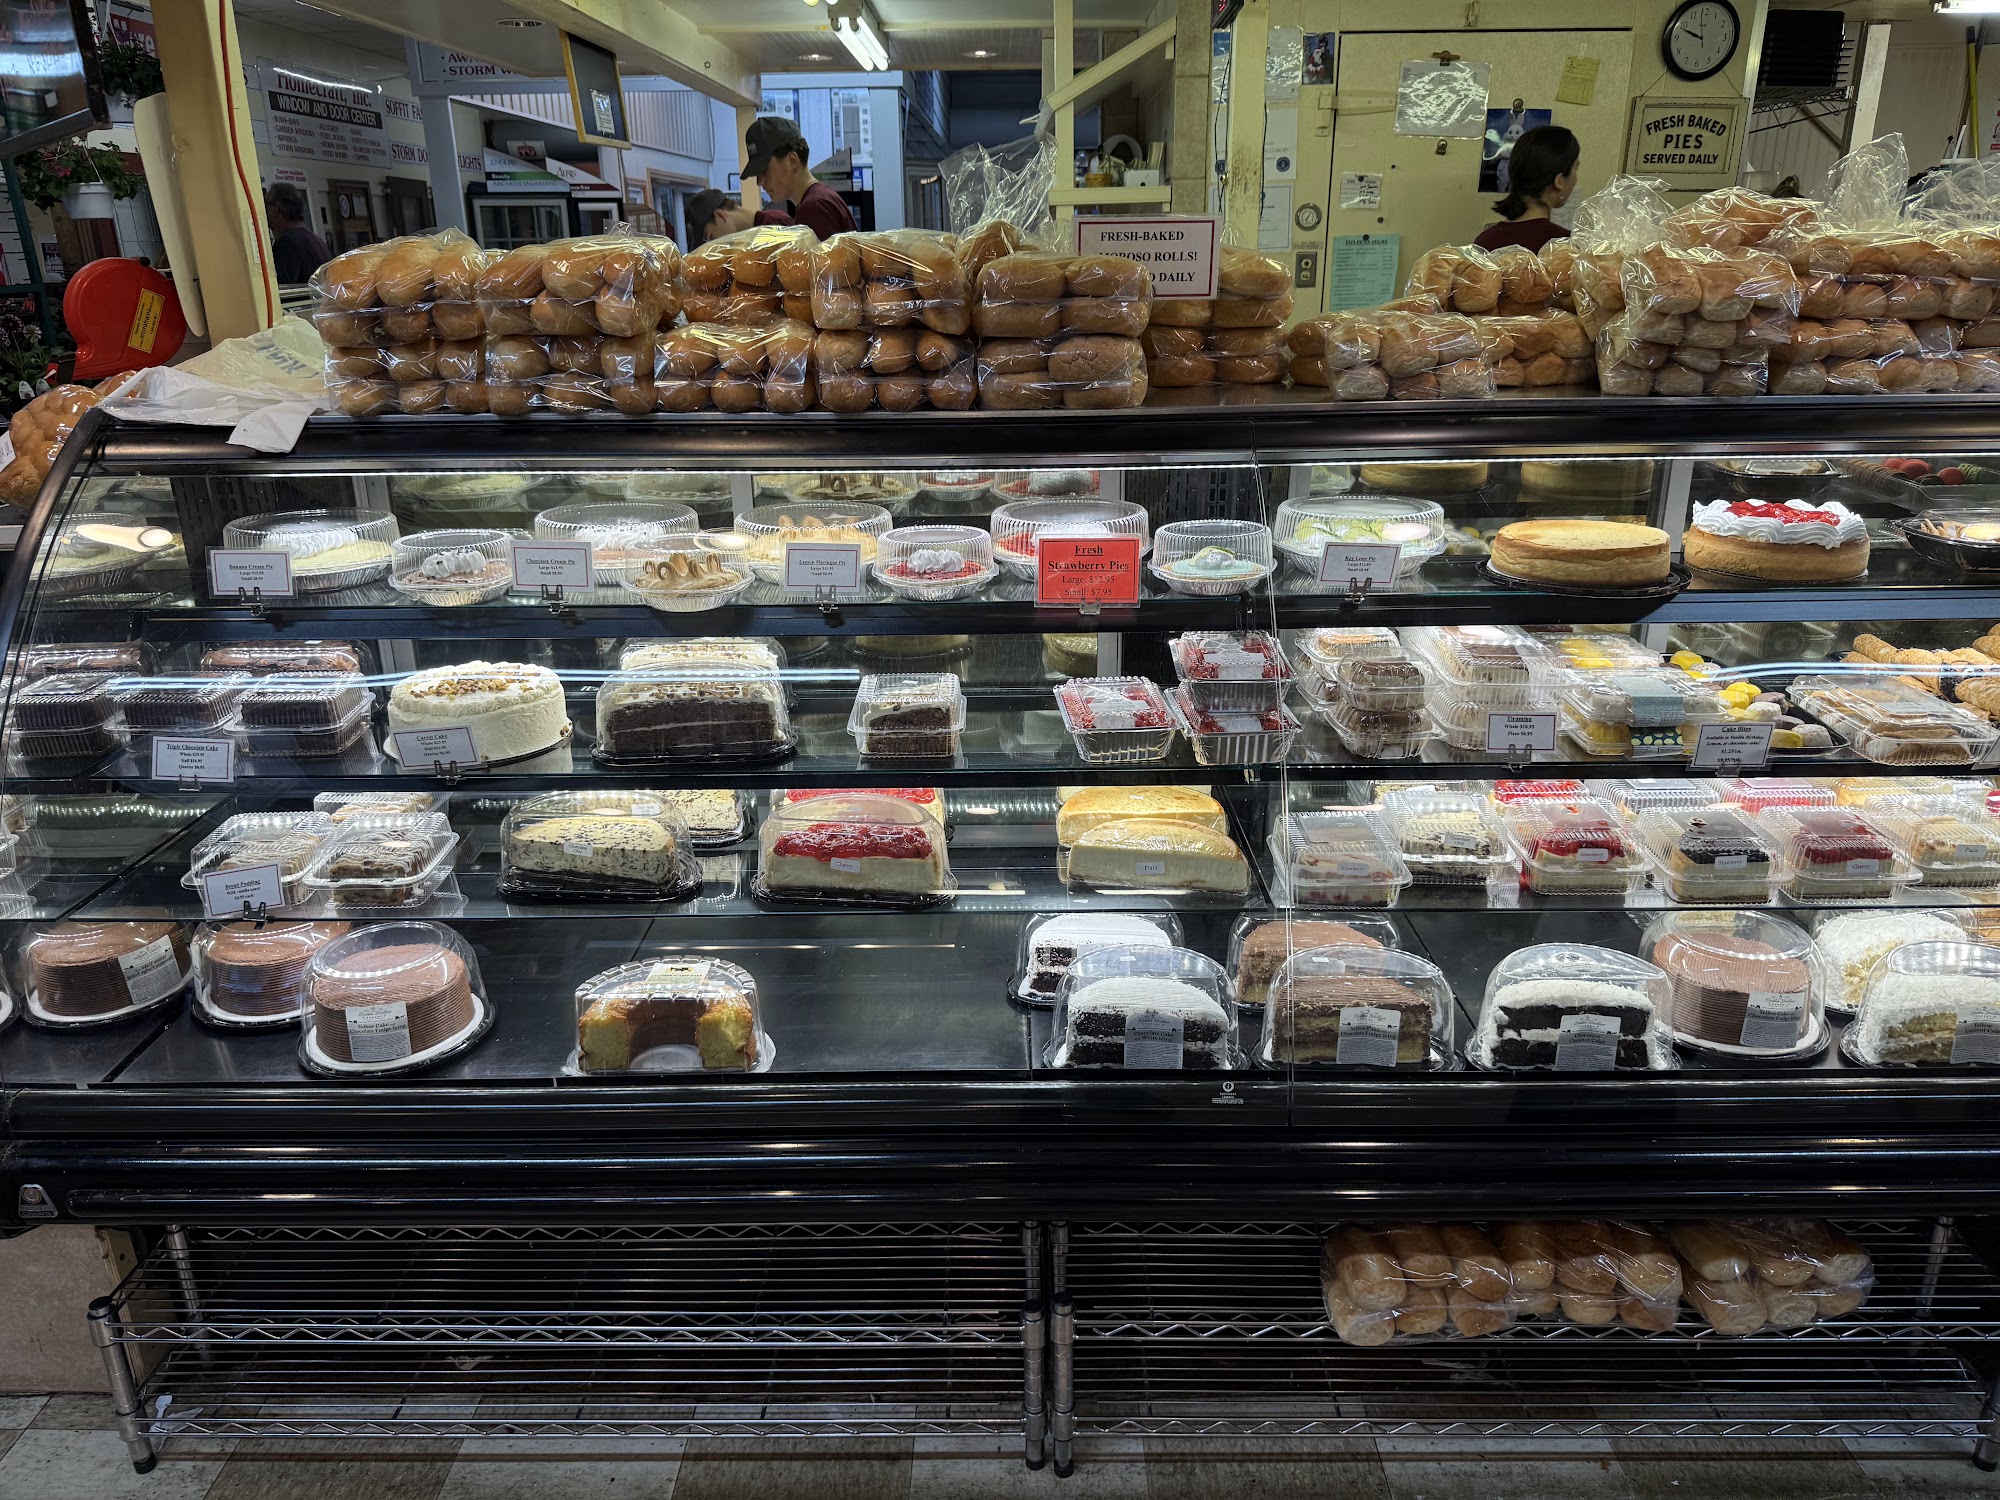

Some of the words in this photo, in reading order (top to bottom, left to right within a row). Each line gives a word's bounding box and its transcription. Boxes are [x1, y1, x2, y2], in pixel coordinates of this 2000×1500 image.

[1690, 11, 1697, 20] 11
[1700, 7, 1710, 16] 12
[1714, 11, 1718, 20] 1
[1680, 21, 1688, 30] 10
[1720, 20, 1726, 28] 2
[1674, 34, 1680, 42] 9
[1722, 33, 1727, 42] 3
[1676, 47, 1682, 55] 8
[1715, 46, 1721, 54] 4
[1684, 57, 1689, 65] 7
[1694, 60, 1699, 68] 6
[1706, 56, 1712, 65] 5
[449, 66, 496, 75] STORM
[277, 73, 348, 105] Homecraft,
[277, 94, 310, 113] WINDOW
[313, 102, 328, 116] AND
[329, 105, 350, 121] DOOR
[351, 109, 377, 125] CENTER
[385, 100, 410, 118] SOFFIT
[1646, 115, 1684, 136] FRESH
[1688, 115, 1726, 137] BAKED
[1664, 134, 1703, 149] PIES
[391, 144, 415, 162] STORM
[1643, 153, 1685, 164] SERVED
[1688, 154, 1719, 164] DAILY
[1100, 231, 1184, 241] FRESH-BAKED
[1154, 251, 1198, 262] ROLLS!
[1159, 272, 1195, 282] DAILY
[1075, 545, 1103, 555] Fresh
[1048, 561, 1106, 570] Strawberry
[1110, 561, 1129, 570] Pies
[1062, 576, 1087, 585] Large:
